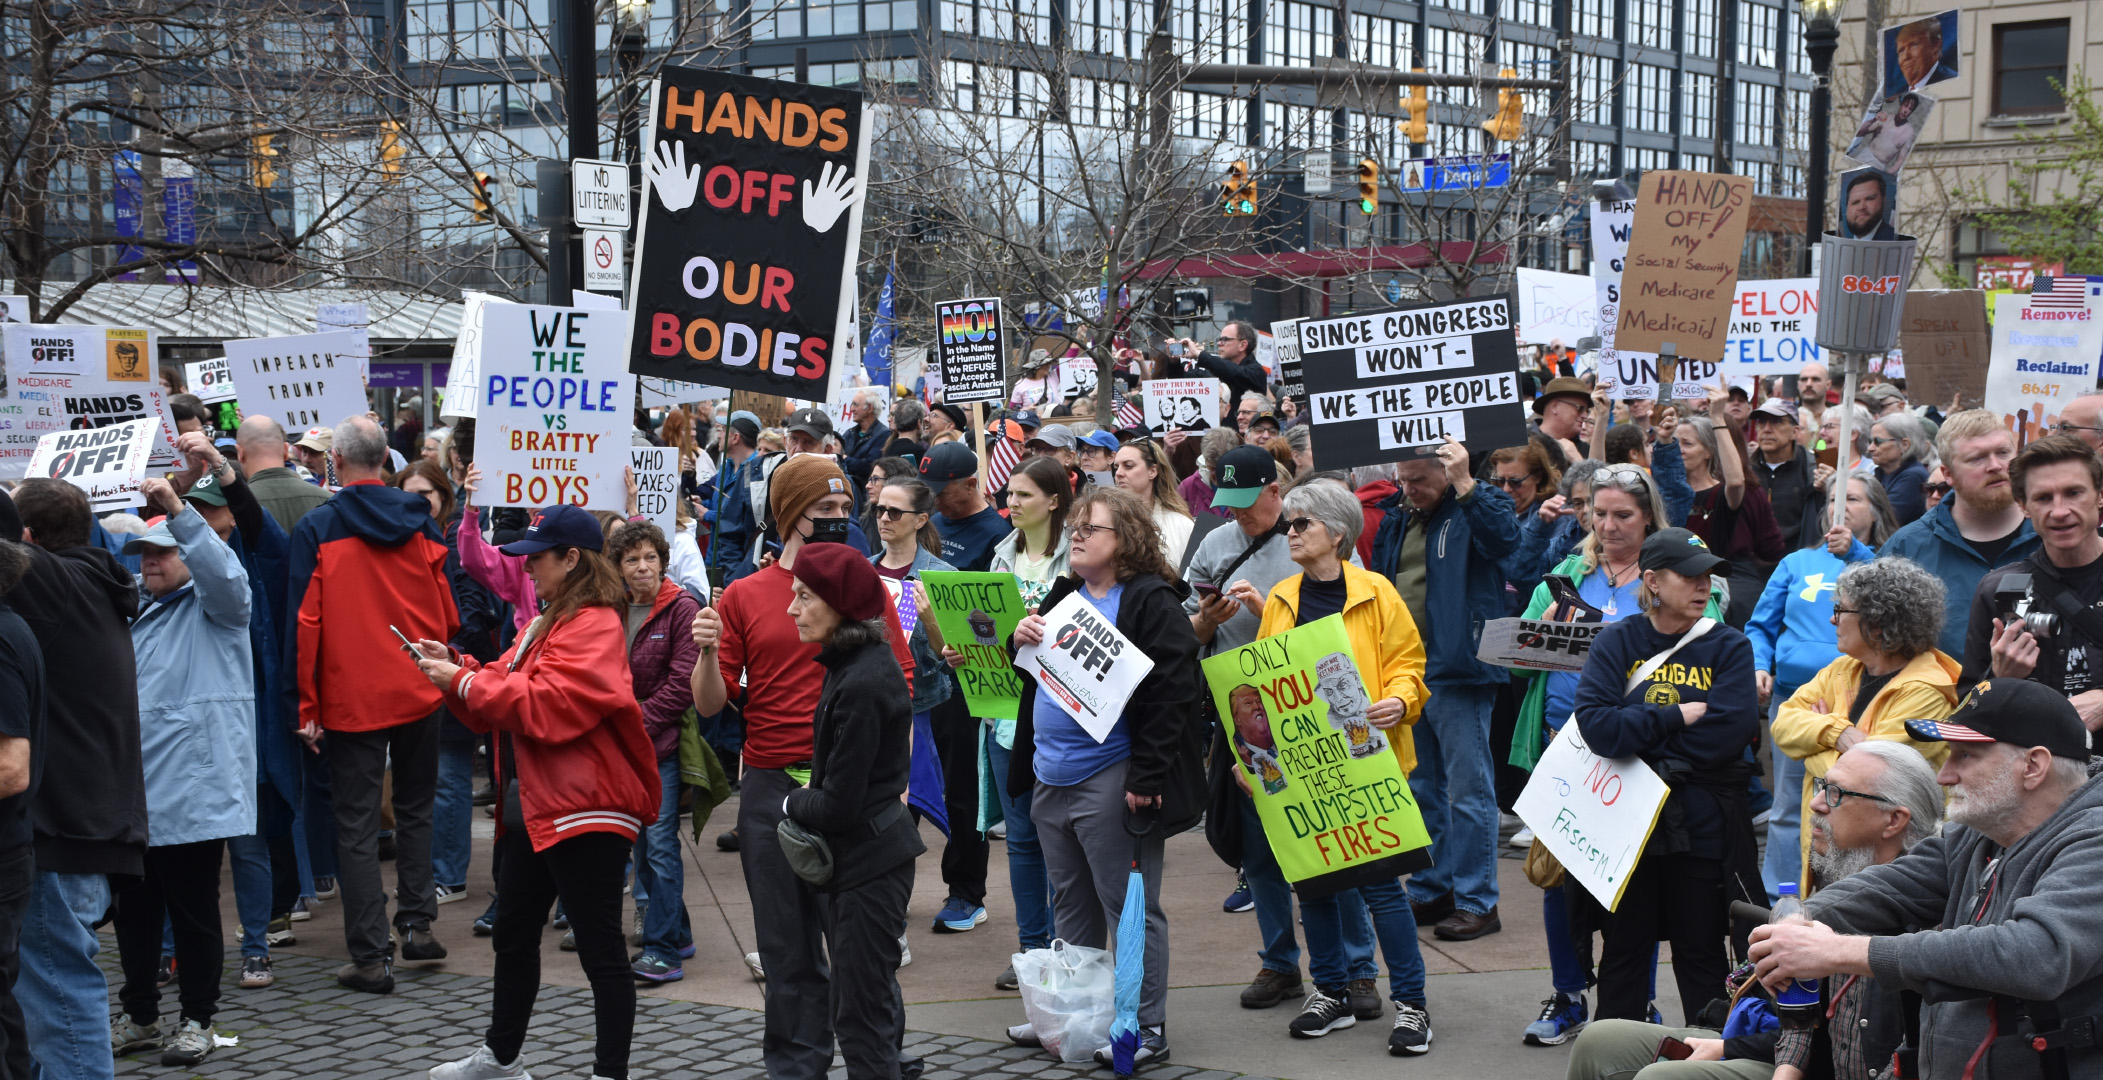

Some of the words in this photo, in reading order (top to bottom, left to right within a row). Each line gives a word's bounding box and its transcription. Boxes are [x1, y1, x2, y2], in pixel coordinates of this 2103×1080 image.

[665, 86, 849, 152] HANDS
[594, 169, 609, 188] NO
[578, 190, 625, 212] LITTERING
[703, 165, 795, 216] OFF
[1655, 173, 1747, 210] HANDS
[1666, 205, 1734, 239] OFF!
[1671, 234, 1701, 255] My
[588, 272, 596, 280] NO
[597, 272, 622, 281] SMOKING
[1635, 253, 1680, 269] Social
[1685, 259, 1734, 285] Security
[682, 256, 795, 312] OUR
[1640, 281, 1715, 301] Medicare
[1842, 275, 1900, 295] 8647
[1733, 289, 1819, 316] ELON
[942, 302, 996, 344] NO!
[1623, 310, 1717, 340] Medicaid
[2021, 308, 2092, 320] Remove!
[531, 309, 589, 348] WE
[1281, 324, 1297, 339] LOVE
[1306, 320, 1373, 349] SINCE
[1384, 303, 1507, 339] CONGRESS
[1730, 322, 1762, 334] AND
[1770, 320, 1800, 332] THE
[1912, 318, 1959, 333] SPEAK
[31, 338, 74, 348] HANDS
[650, 312, 828, 379] BODIES
[946, 347, 954, 355] In
[956, 346, 969, 354] the
[971, 344, 995, 353] Name
[32, 348, 75, 364] OFF!
[253, 352, 334, 374] IMPEACH
[532, 351, 585, 373] THE
[947, 355, 955, 364] of
[957, 353, 996, 363] Humanity
[1366, 341, 1447, 373] WON'T
[947, 366, 961, 374] We
[962, 362, 997, 373] REFUSE
[961, 372, 988, 382] Accept
[1617, 357, 1717, 386] UNTED
[2016, 359, 2090, 376] Reclaim!
[18, 377, 72, 388] MEDICARE
[268, 381, 325, 400] TRUMP
[488, 375, 618, 412] PEOPLE
[943, 382, 970, 392] Fascist
[971, 380, 1004, 389] America
[2021, 383, 2061, 397] 8647
[64, 394, 144, 415] HANDS
[1319, 393, 1358, 419] WE
[1366, 387, 1414, 413] THE
[1425, 376, 1513, 408] PEOPLE
[287, 409, 321, 427] NOW
[543, 414, 567, 430] VS
[56, 425, 135, 451] HANDS
[1392, 416, 1452, 444] WILL
[49, 444, 130, 479] OFF!
[532, 457, 577, 471] LITTLE
[632, 450, 663, 470] WHO
[633, 473, 674, 493] TAXES
[632, 494, 667, 515] EED
[930, 582, 1007, 614] PROTECT
[1071, 607, 1124, 656] HANDS
[1051, 623, 1114, 682] OFF!
[1239, 634, 1291, 677] ONLY
[1260, 669, 1313, 714] YOU
[1281, 710, 1321, 743] CAN
[1281, 732, 1348, 775] PREVENT
[1299, 764, 1353, 799] THESE
[1551, 776, 1571, 797] TO
[1583, 758, 1622, 807] NO
[1284, 777, 1412, 838] DUMPSTER
[1314, 816, 1401, 867] FIRES
